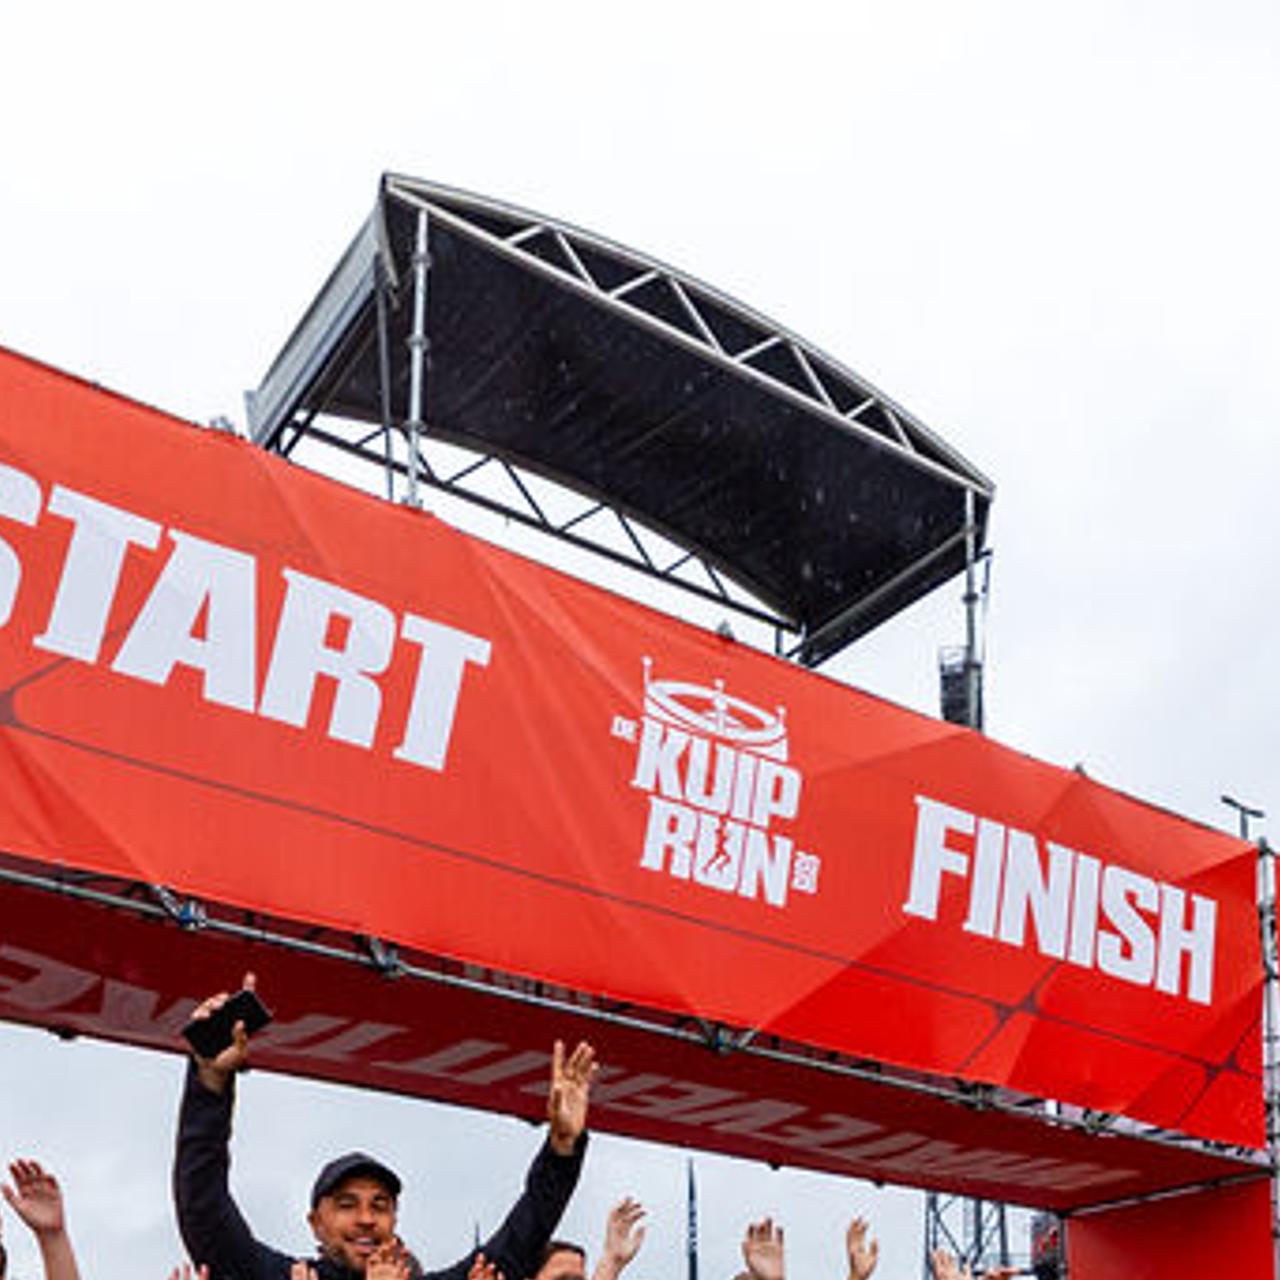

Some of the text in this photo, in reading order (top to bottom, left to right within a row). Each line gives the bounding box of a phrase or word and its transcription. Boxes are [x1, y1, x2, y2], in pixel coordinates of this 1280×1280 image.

[630, 715, 802, 827] KUIP
[640, 795, 794, 907] RUN
[901, 793, 1218, 1006] FINISH
